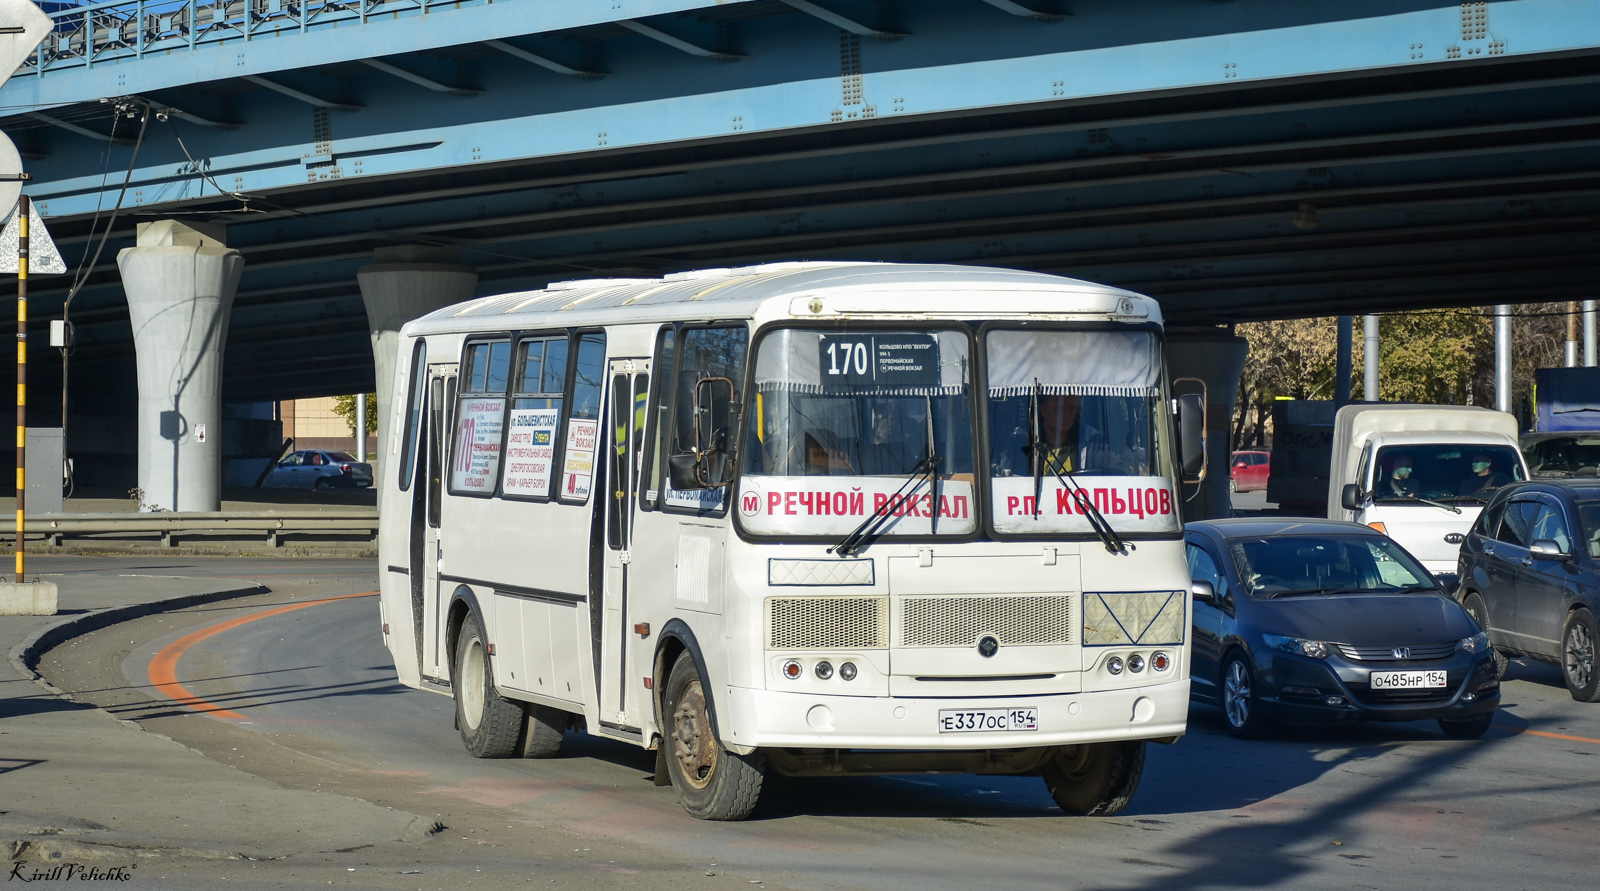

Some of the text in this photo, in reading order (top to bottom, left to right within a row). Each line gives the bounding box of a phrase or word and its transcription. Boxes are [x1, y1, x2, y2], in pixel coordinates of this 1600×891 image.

[827, 342, 868, 375] 170
[485, 402, 501, 412] ВОКЗАЛ
[577, 425, 595, 436] РЕЧНОЙ
[456, 418, 475, 473] 170
[576, 437, 594, 449] ВОКЗАЛ
[567, 459, 592, 472] ВЕСЕННИЙ
[464, 477, 485, 488] КОЛЬЦОВО
[767, 486, 865, 516] РЕЧНОЙ
[873, 492, 969, 519] ВОКЗАЛ
[1007, 495, 1043, 516] Р.П.
[1375, 672, 1446, 687] О485НР 154
[944, 711, 1034, 730] Е337ОС 154
